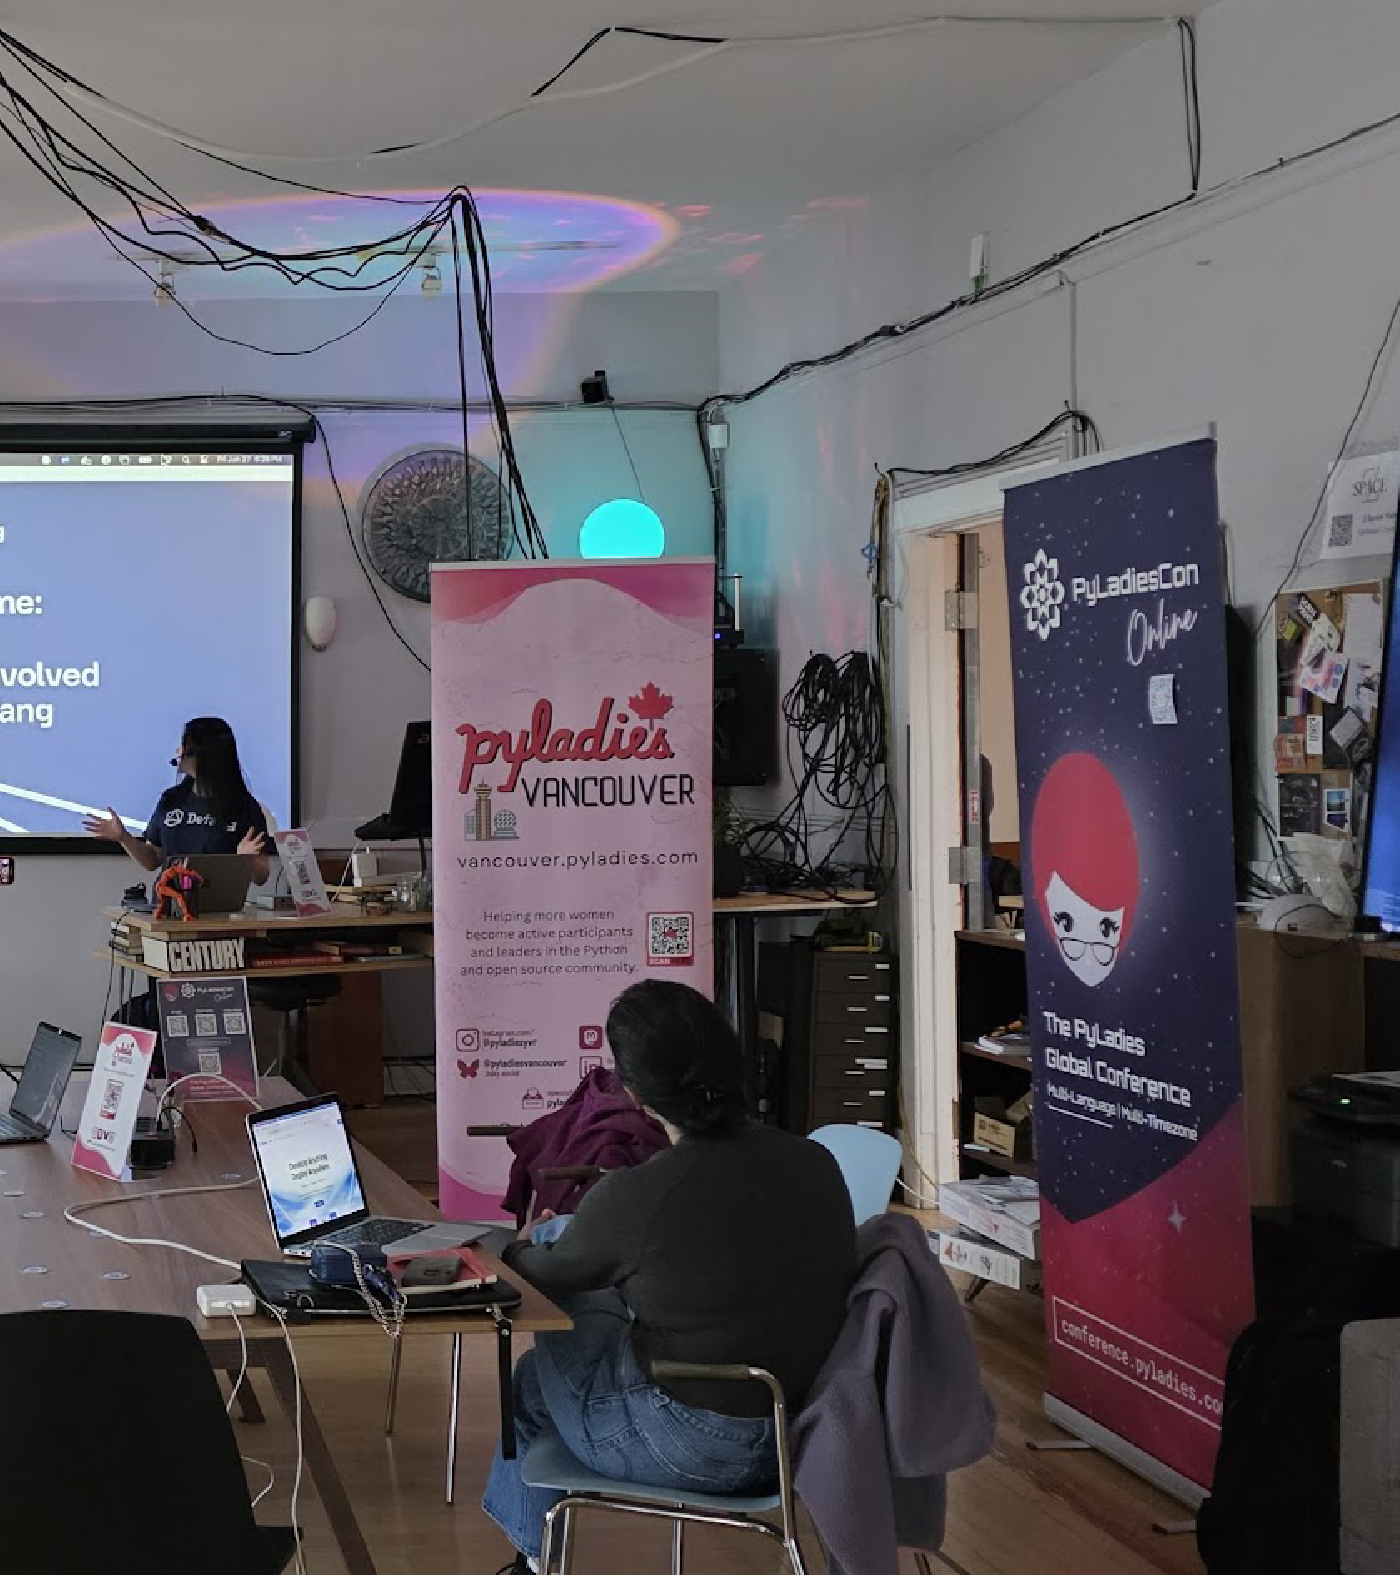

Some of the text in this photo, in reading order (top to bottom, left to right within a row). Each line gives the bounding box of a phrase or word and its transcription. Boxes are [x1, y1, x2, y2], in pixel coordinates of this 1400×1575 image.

[1072, 563, 1199, 606] PyLadiesCon
[1127, 598, 1198, 666] Online
[456, 697, 676, 794] pyladies
[521, 773, 695, 807] VANCOUVER
[456, 850, 698, 870] vancouver.pyladies.com
[465, 926, 634, 941] become active participants
[483, 910, 615, 924] Helping more women
[168, 936, 245, 972] CENTURY
[470, 944, 628, 958] and leaders in the Python
[460, 964, 483, 976] and
[486, 966, 518, 977] open
[520, 965, 563, 976] source
[565, 961, 640, 975] community.
[1042, 1011, 1146, 1057] The PyLadies
[1044, 1046, 1191, 1108] Global Conference
